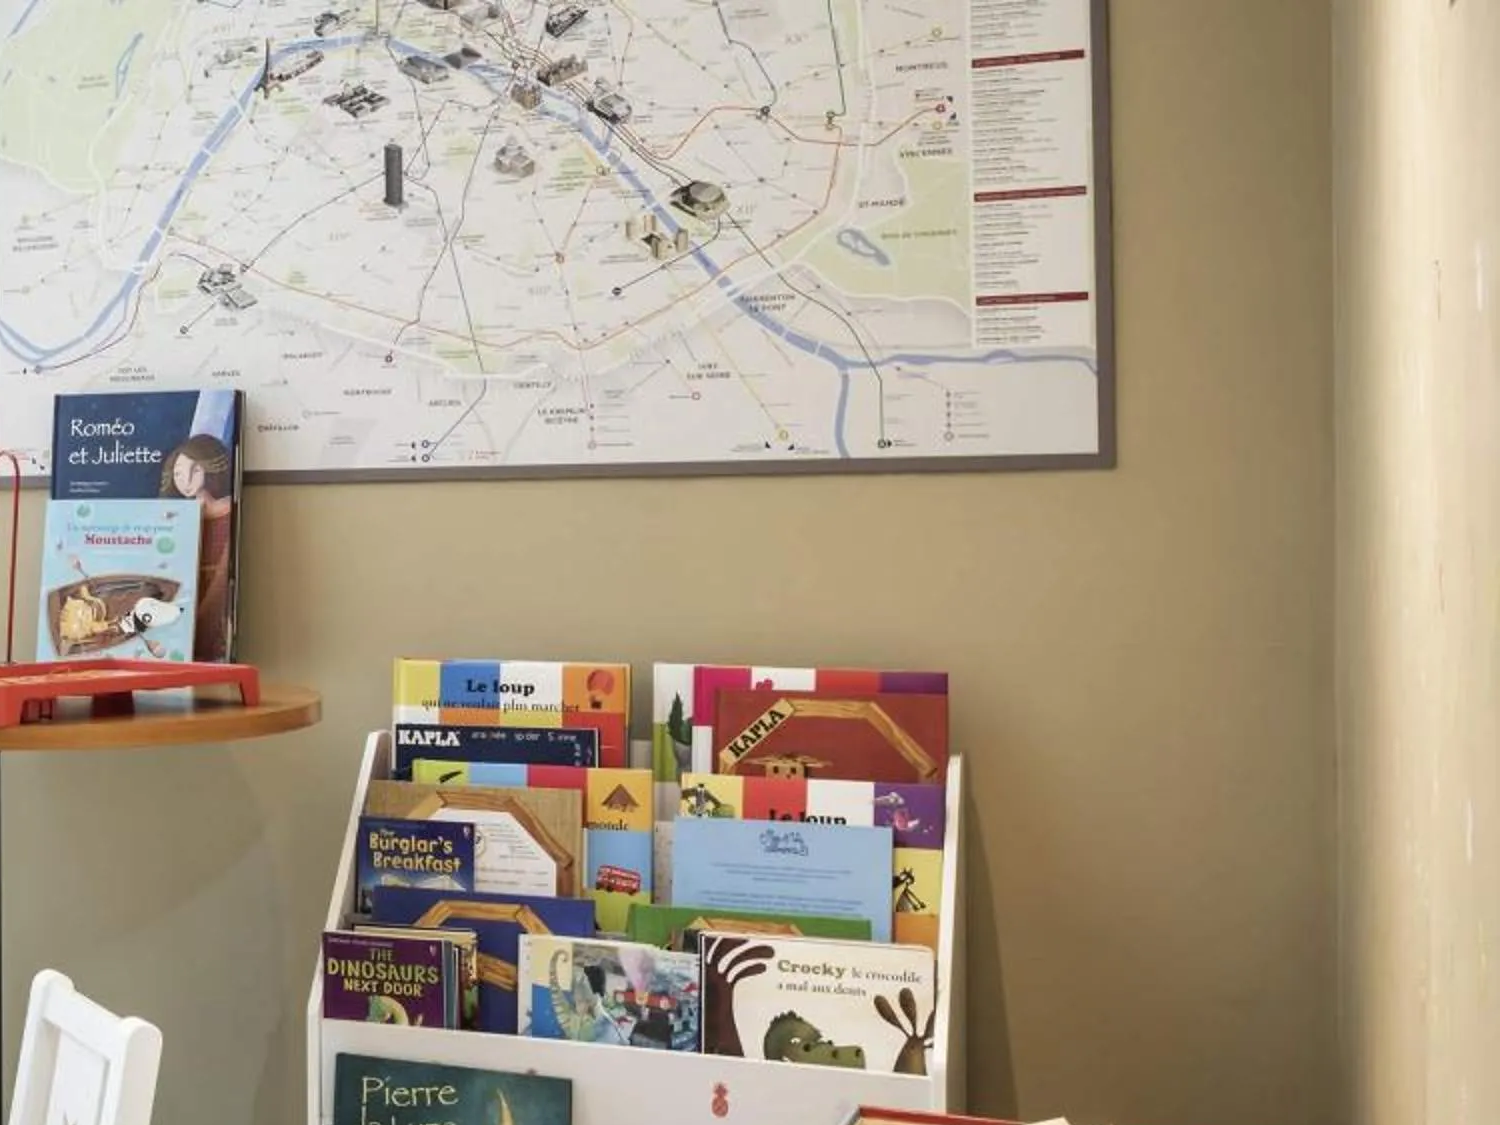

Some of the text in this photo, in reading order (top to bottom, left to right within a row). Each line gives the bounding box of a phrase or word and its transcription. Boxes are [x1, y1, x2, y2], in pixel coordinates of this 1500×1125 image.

[70, 417, 135, 437] Roméo
[68, 439, 162, 465] et Juliette
[466, 678, 536, 696] Le loup
[503, 699, 528, 713] plus
[398, 729, 461, 747] KAPLA
[728, 708, 785, 758] KAPLA
[369, 831, 453, 854] Burglar's
[373, 851, 462, 873] Breakfast
[369, 948, 394, 961] THE
[326, 957, 439, 984] DINOSAURS
[777, 959, 847, 979] Crocky
[343, 978, 423, 997] NEXT DOOR
[785, 981, 808, 992] mal
[361, 1076, 459, 1107] Pierre
